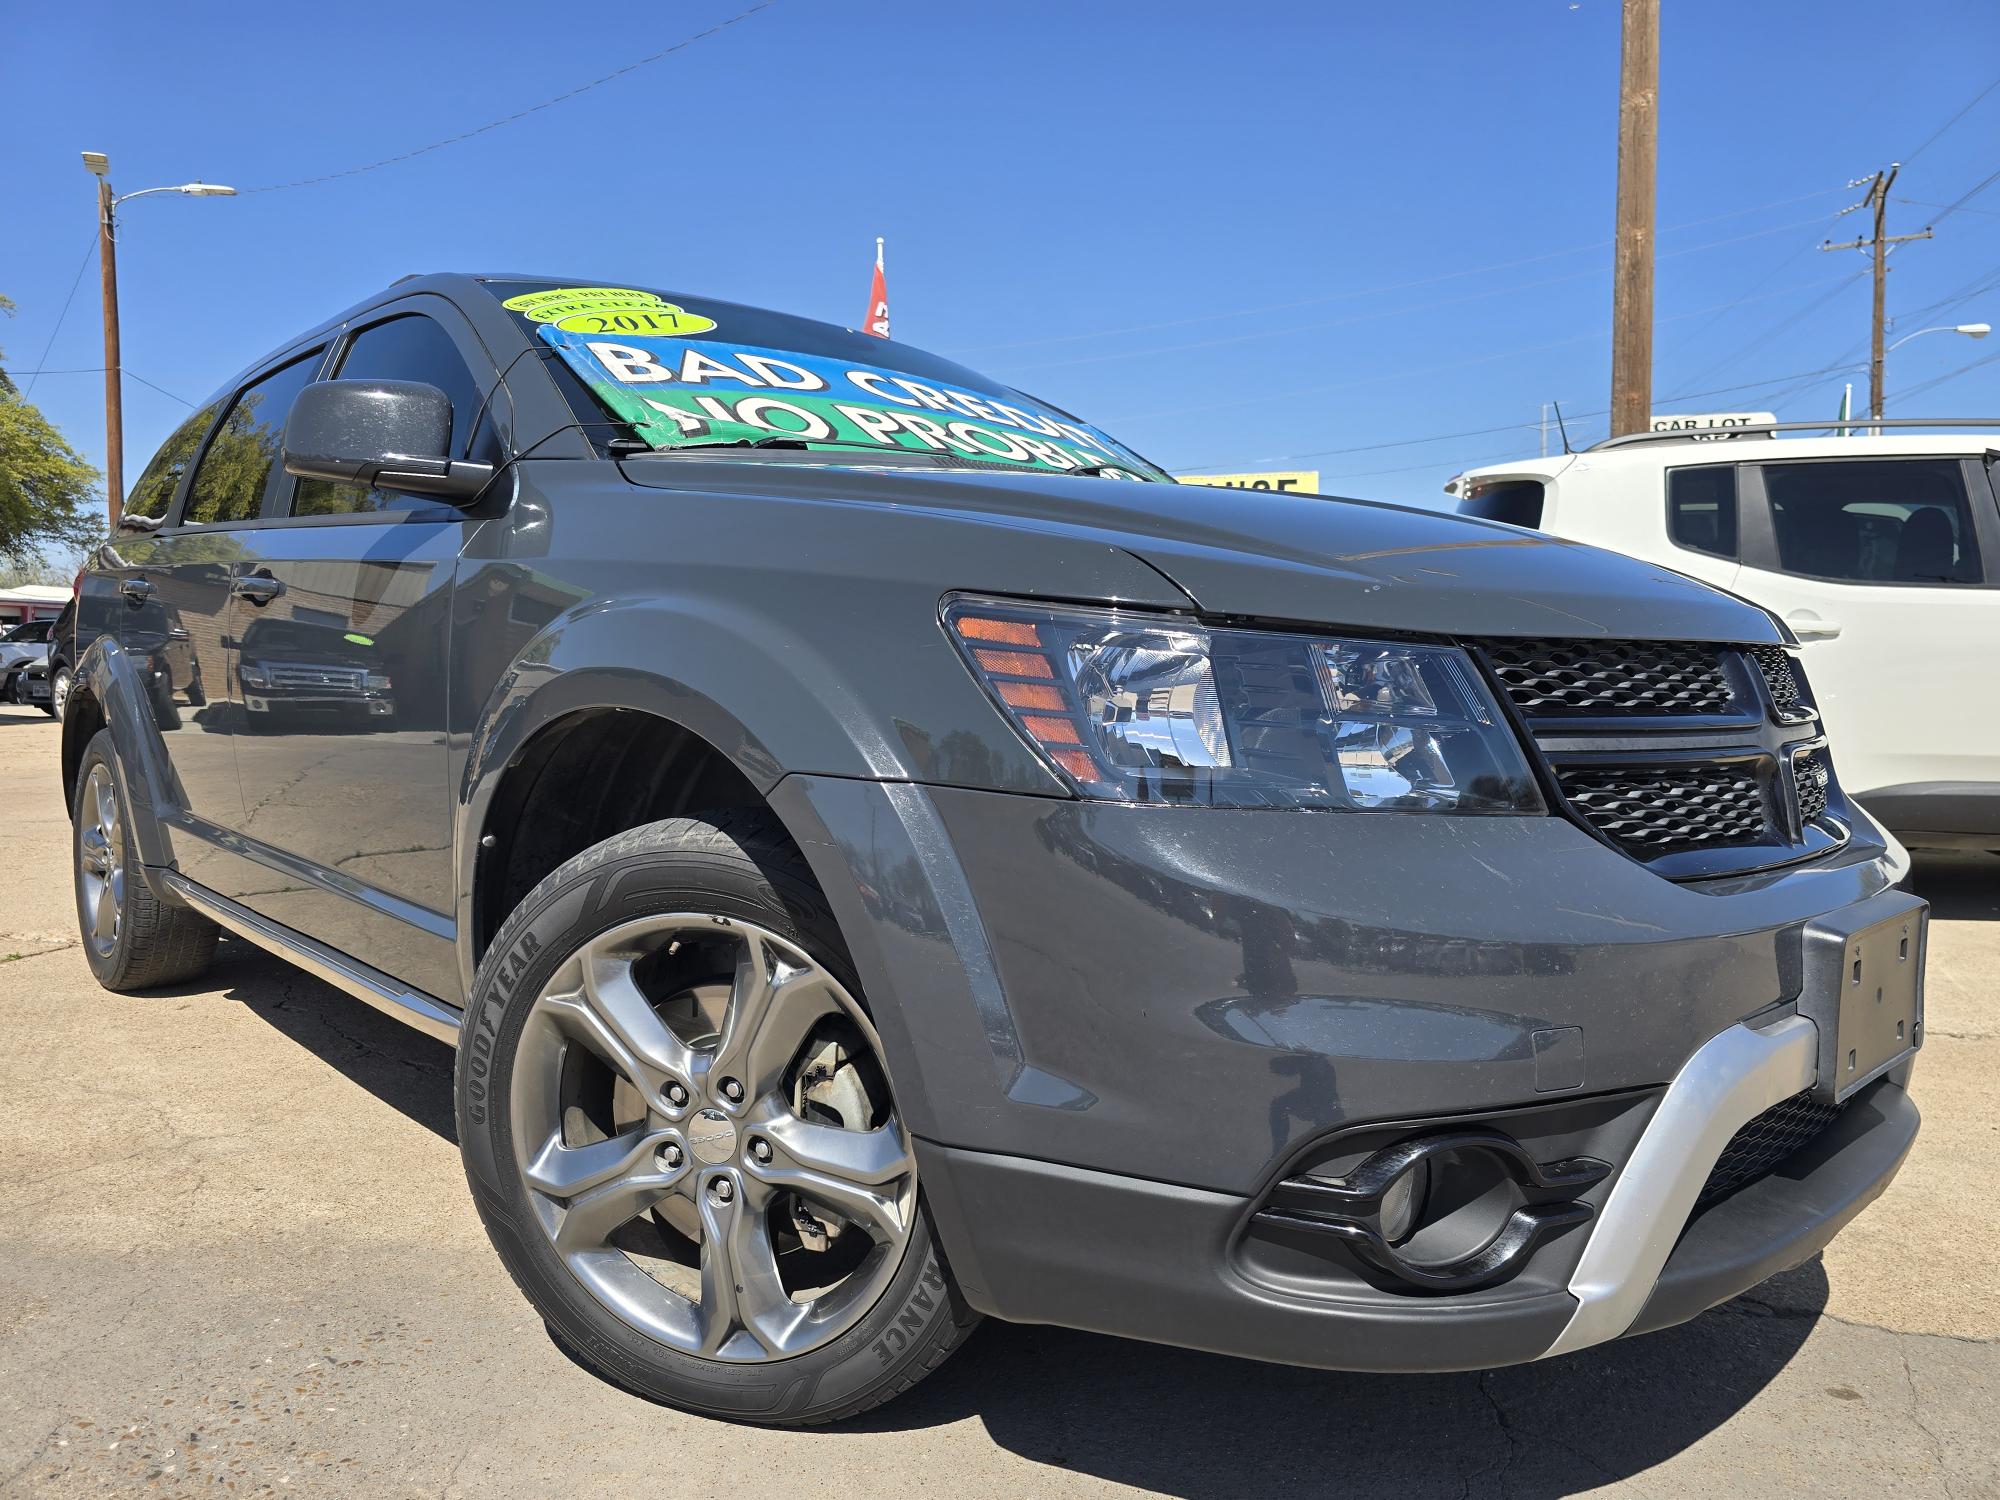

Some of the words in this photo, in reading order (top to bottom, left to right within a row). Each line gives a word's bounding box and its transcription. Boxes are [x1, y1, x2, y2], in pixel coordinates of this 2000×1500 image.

[535, 303, 592, 320] EXTRA
[600, 301, 668, 310] CLEAN
[587, 312, 680, 333] 2017
[586, 342, 827, 391] BAD
[846, 370, 1119, 459] CREDIT
[641, 396, 832, 440] NO
